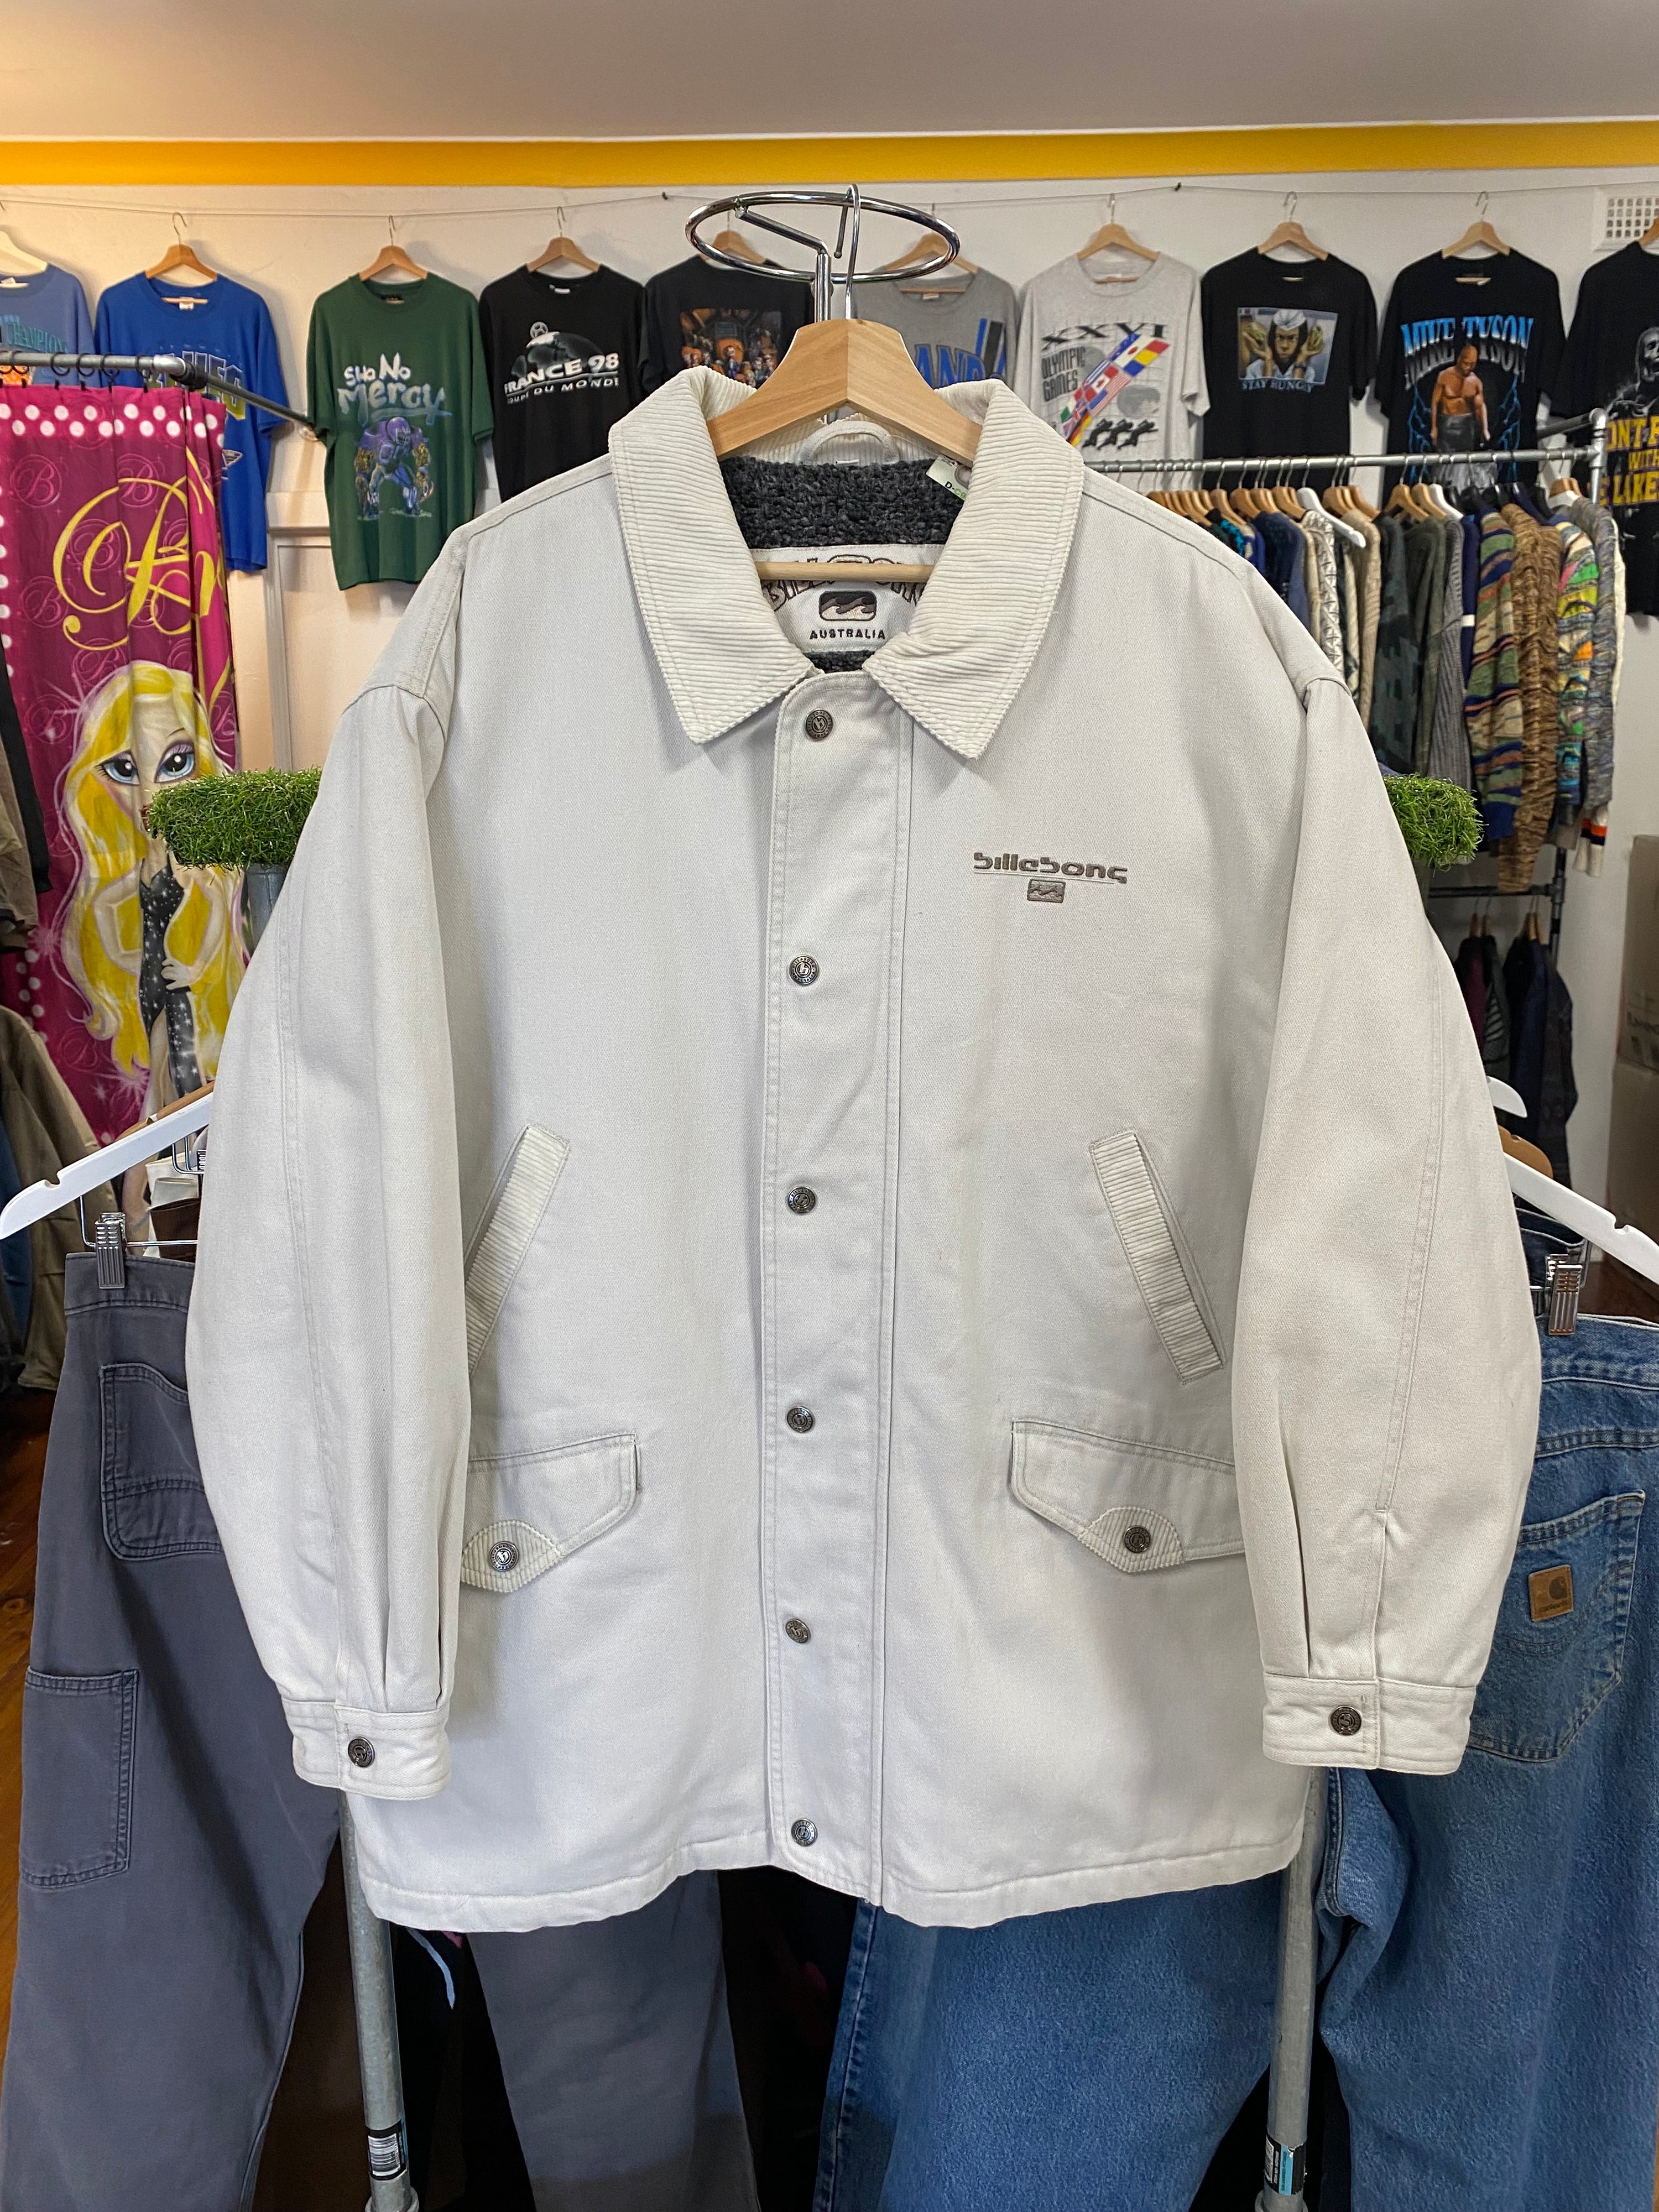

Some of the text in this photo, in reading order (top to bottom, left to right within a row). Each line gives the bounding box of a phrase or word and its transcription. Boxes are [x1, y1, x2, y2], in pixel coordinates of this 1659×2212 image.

[1462, 314, 1535, 349] TYSON
[588, 352, 619, 373] 98
[1041, 346, 1086, 379] OLYMPIC
[534, 384, 554, 395] DU
[1043, 369, 1078, 402] GAMES
[1613, 471, 1659, 507] LAKE
[809, 628, 885, 640] AUSTRALIA
